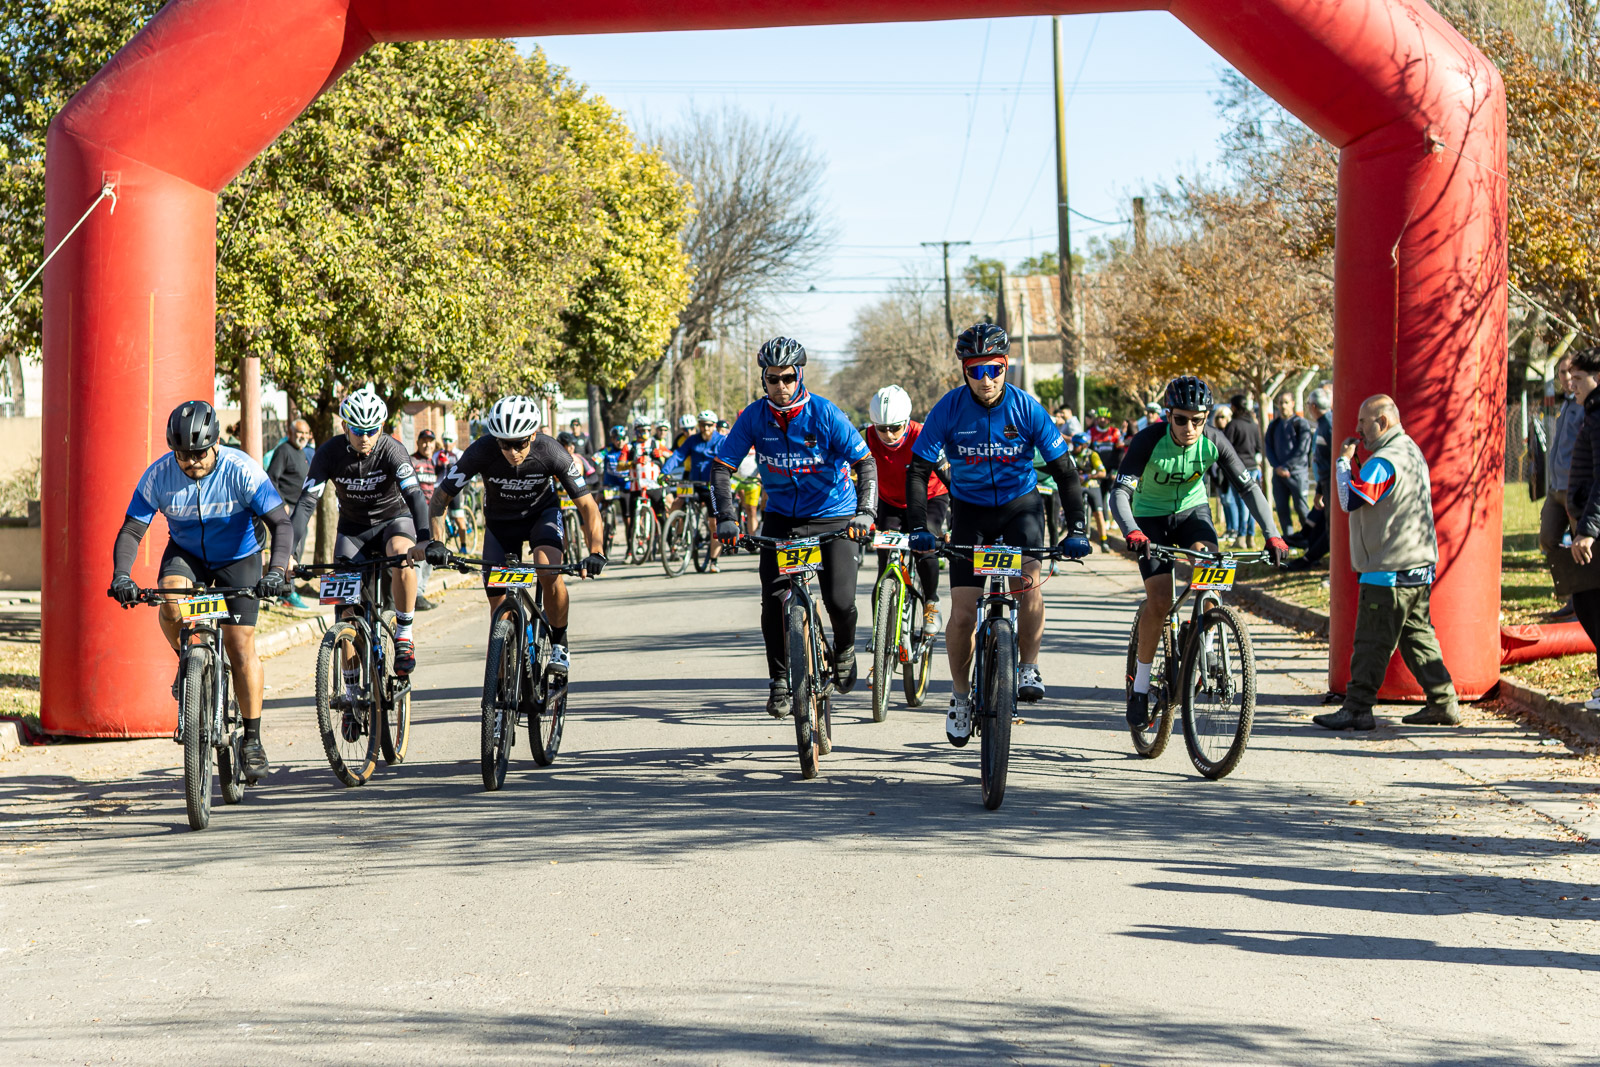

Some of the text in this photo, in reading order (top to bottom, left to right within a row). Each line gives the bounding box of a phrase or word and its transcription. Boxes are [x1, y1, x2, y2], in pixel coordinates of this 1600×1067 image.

[957, 444, 1024, 457] PELOTON
[758, 452, 825, 468] PELOTON
[335, 474, 388, 486] NACHOS
[488, 477, 546, 486] NACHOS
[1117, 473, 1139, 488] USA
[1154, 470, 1202, 485] USA
[346, 483, 377, 491] BIKE
[165, 500, 239, 517] GIANT
[786, 548, 812, 566] 97
[982, 553, 1014, 568] 98
[498, 572, 528, 582] 113
[1199, 569, 1228, 583] 119
[323, 581, 357, 597] 215
[188, 601, 218, 614] 101
